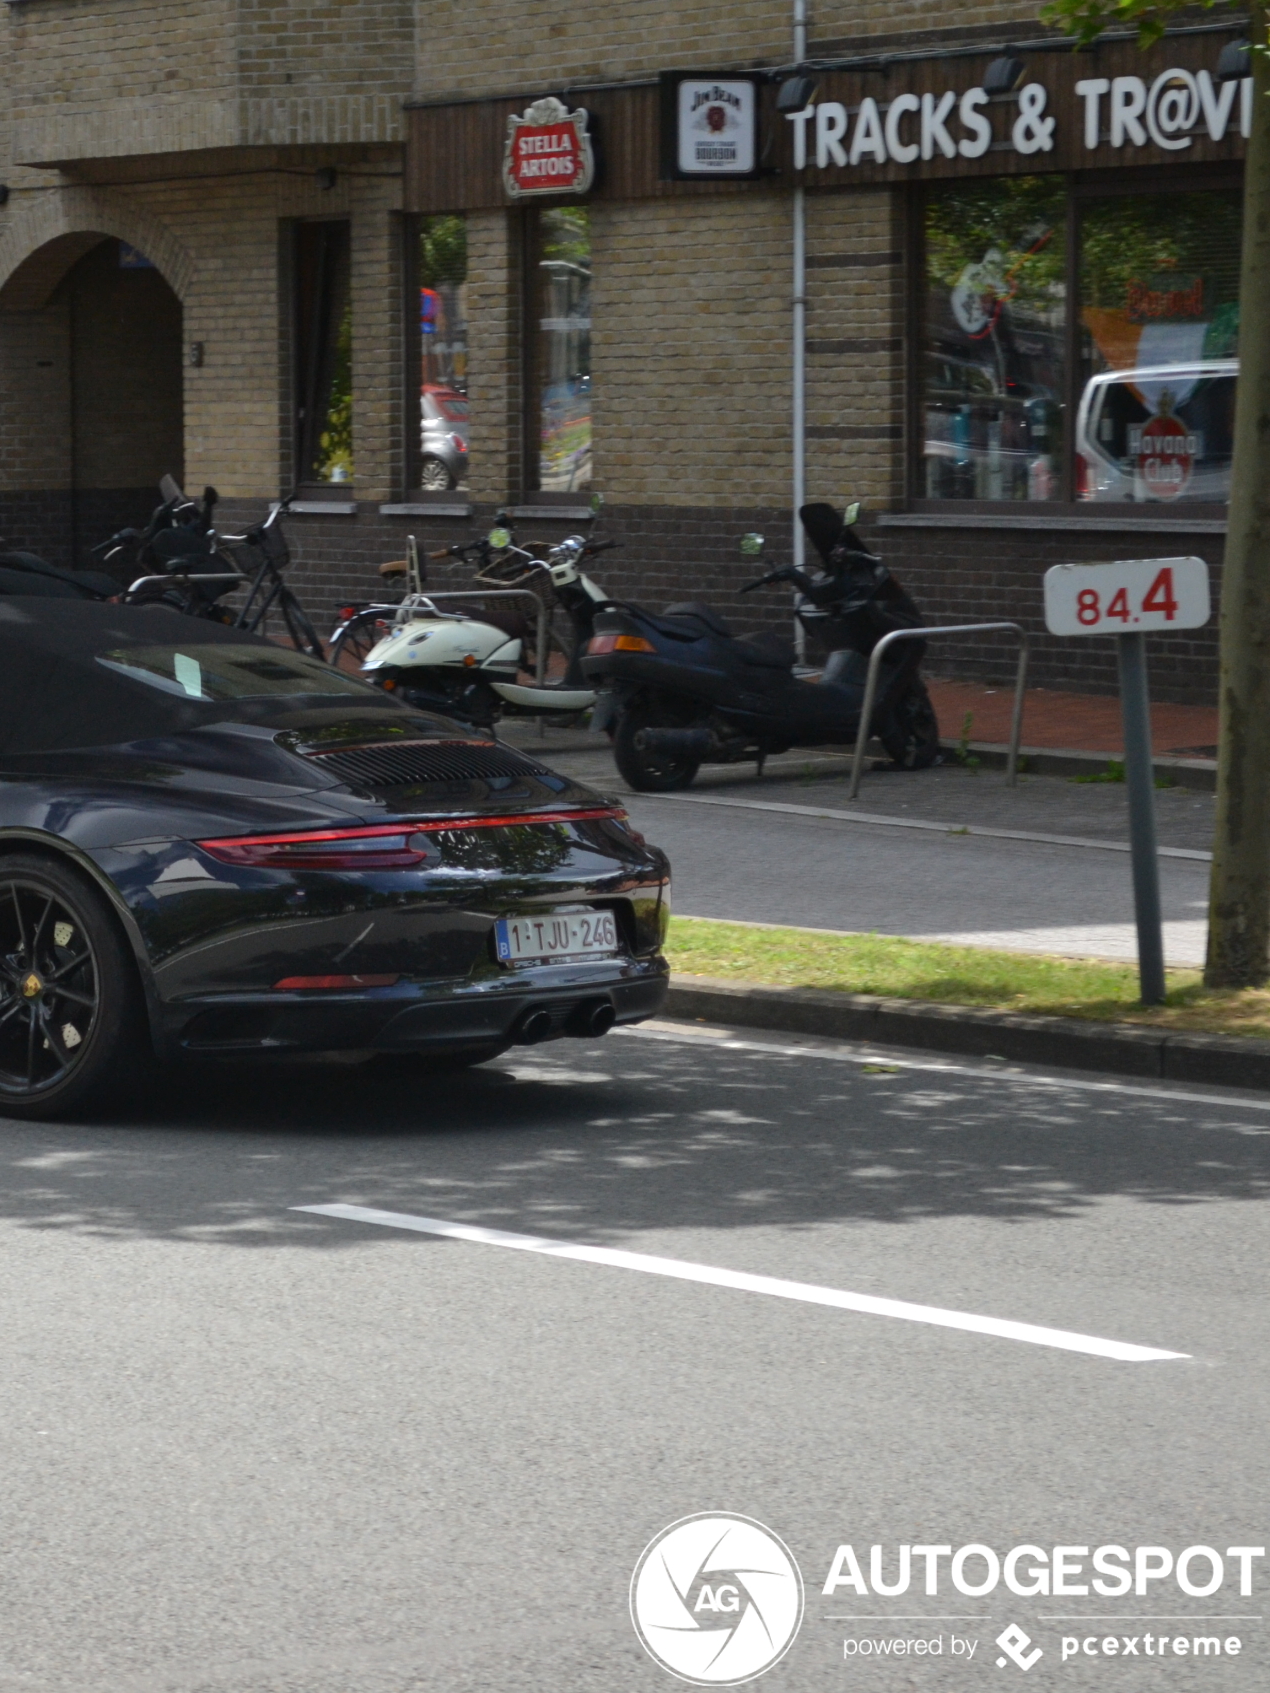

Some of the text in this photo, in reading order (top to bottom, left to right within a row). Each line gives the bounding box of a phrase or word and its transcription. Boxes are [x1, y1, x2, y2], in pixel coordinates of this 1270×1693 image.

[786, 86, 992, 170] TRACKS
[1012, 83, 1055, 155] &
[518, 134, 573, 155] STELLA
[695, 148, 736, 160] BOURBON
[519, 156, 574, 177] ARTOIS
[1130, 429, 1197, 454] Havana
[1144, 457, 1184, 483] Club
[1076, 567, 1179, 626] 84.4
[512, 916, 616, 952] 1-TJU-246
[500, 942, 509, 956] B
